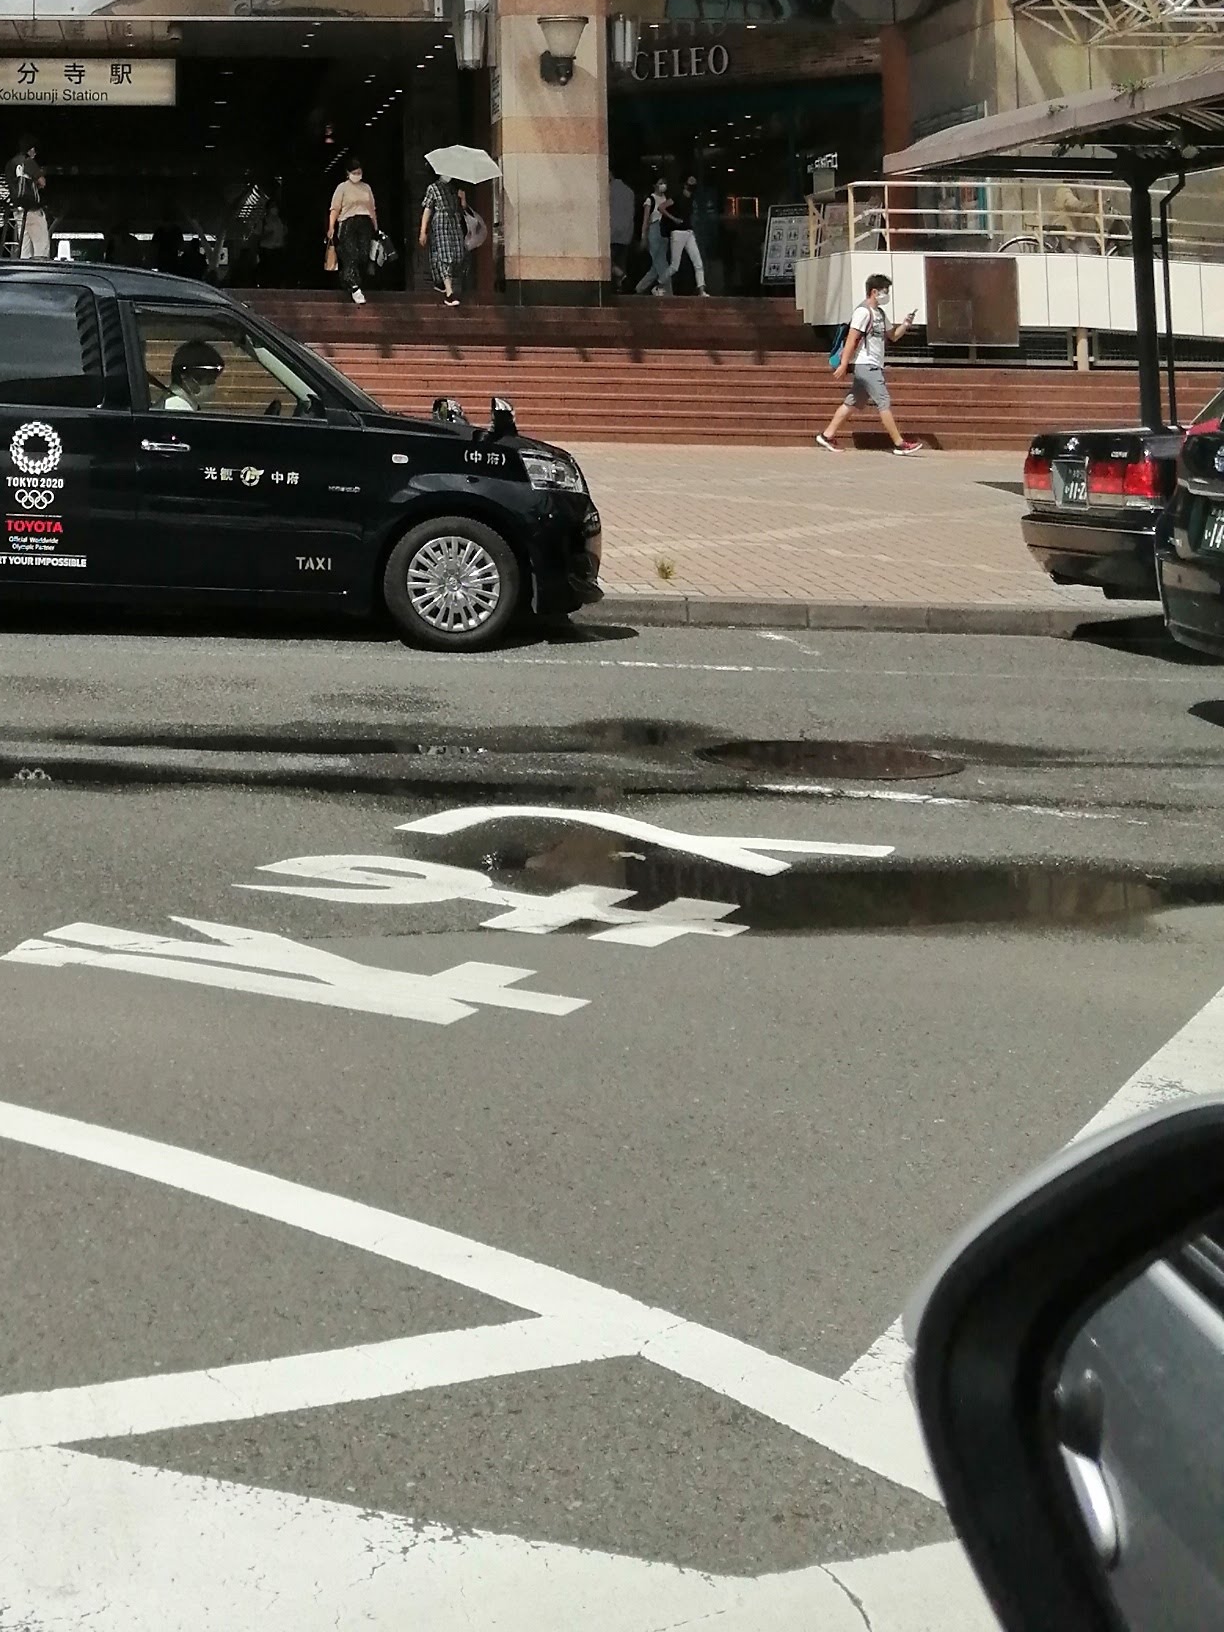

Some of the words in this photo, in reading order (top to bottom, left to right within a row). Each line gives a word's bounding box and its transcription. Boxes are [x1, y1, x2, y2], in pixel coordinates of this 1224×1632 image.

[631, 44, 729, 81] CELEO
[62, 89, 109, 102] Station
[6, 476, 39, 488] TOKYO
[40, 477, 64, 489] 2020
[5, 520, 64, 533] TOYOTA
[8, 556, 34, 566] YOUR
[35, 557, 87, 568] IMPOSSIBLE
[295, 556, 332, 571] TAXI
